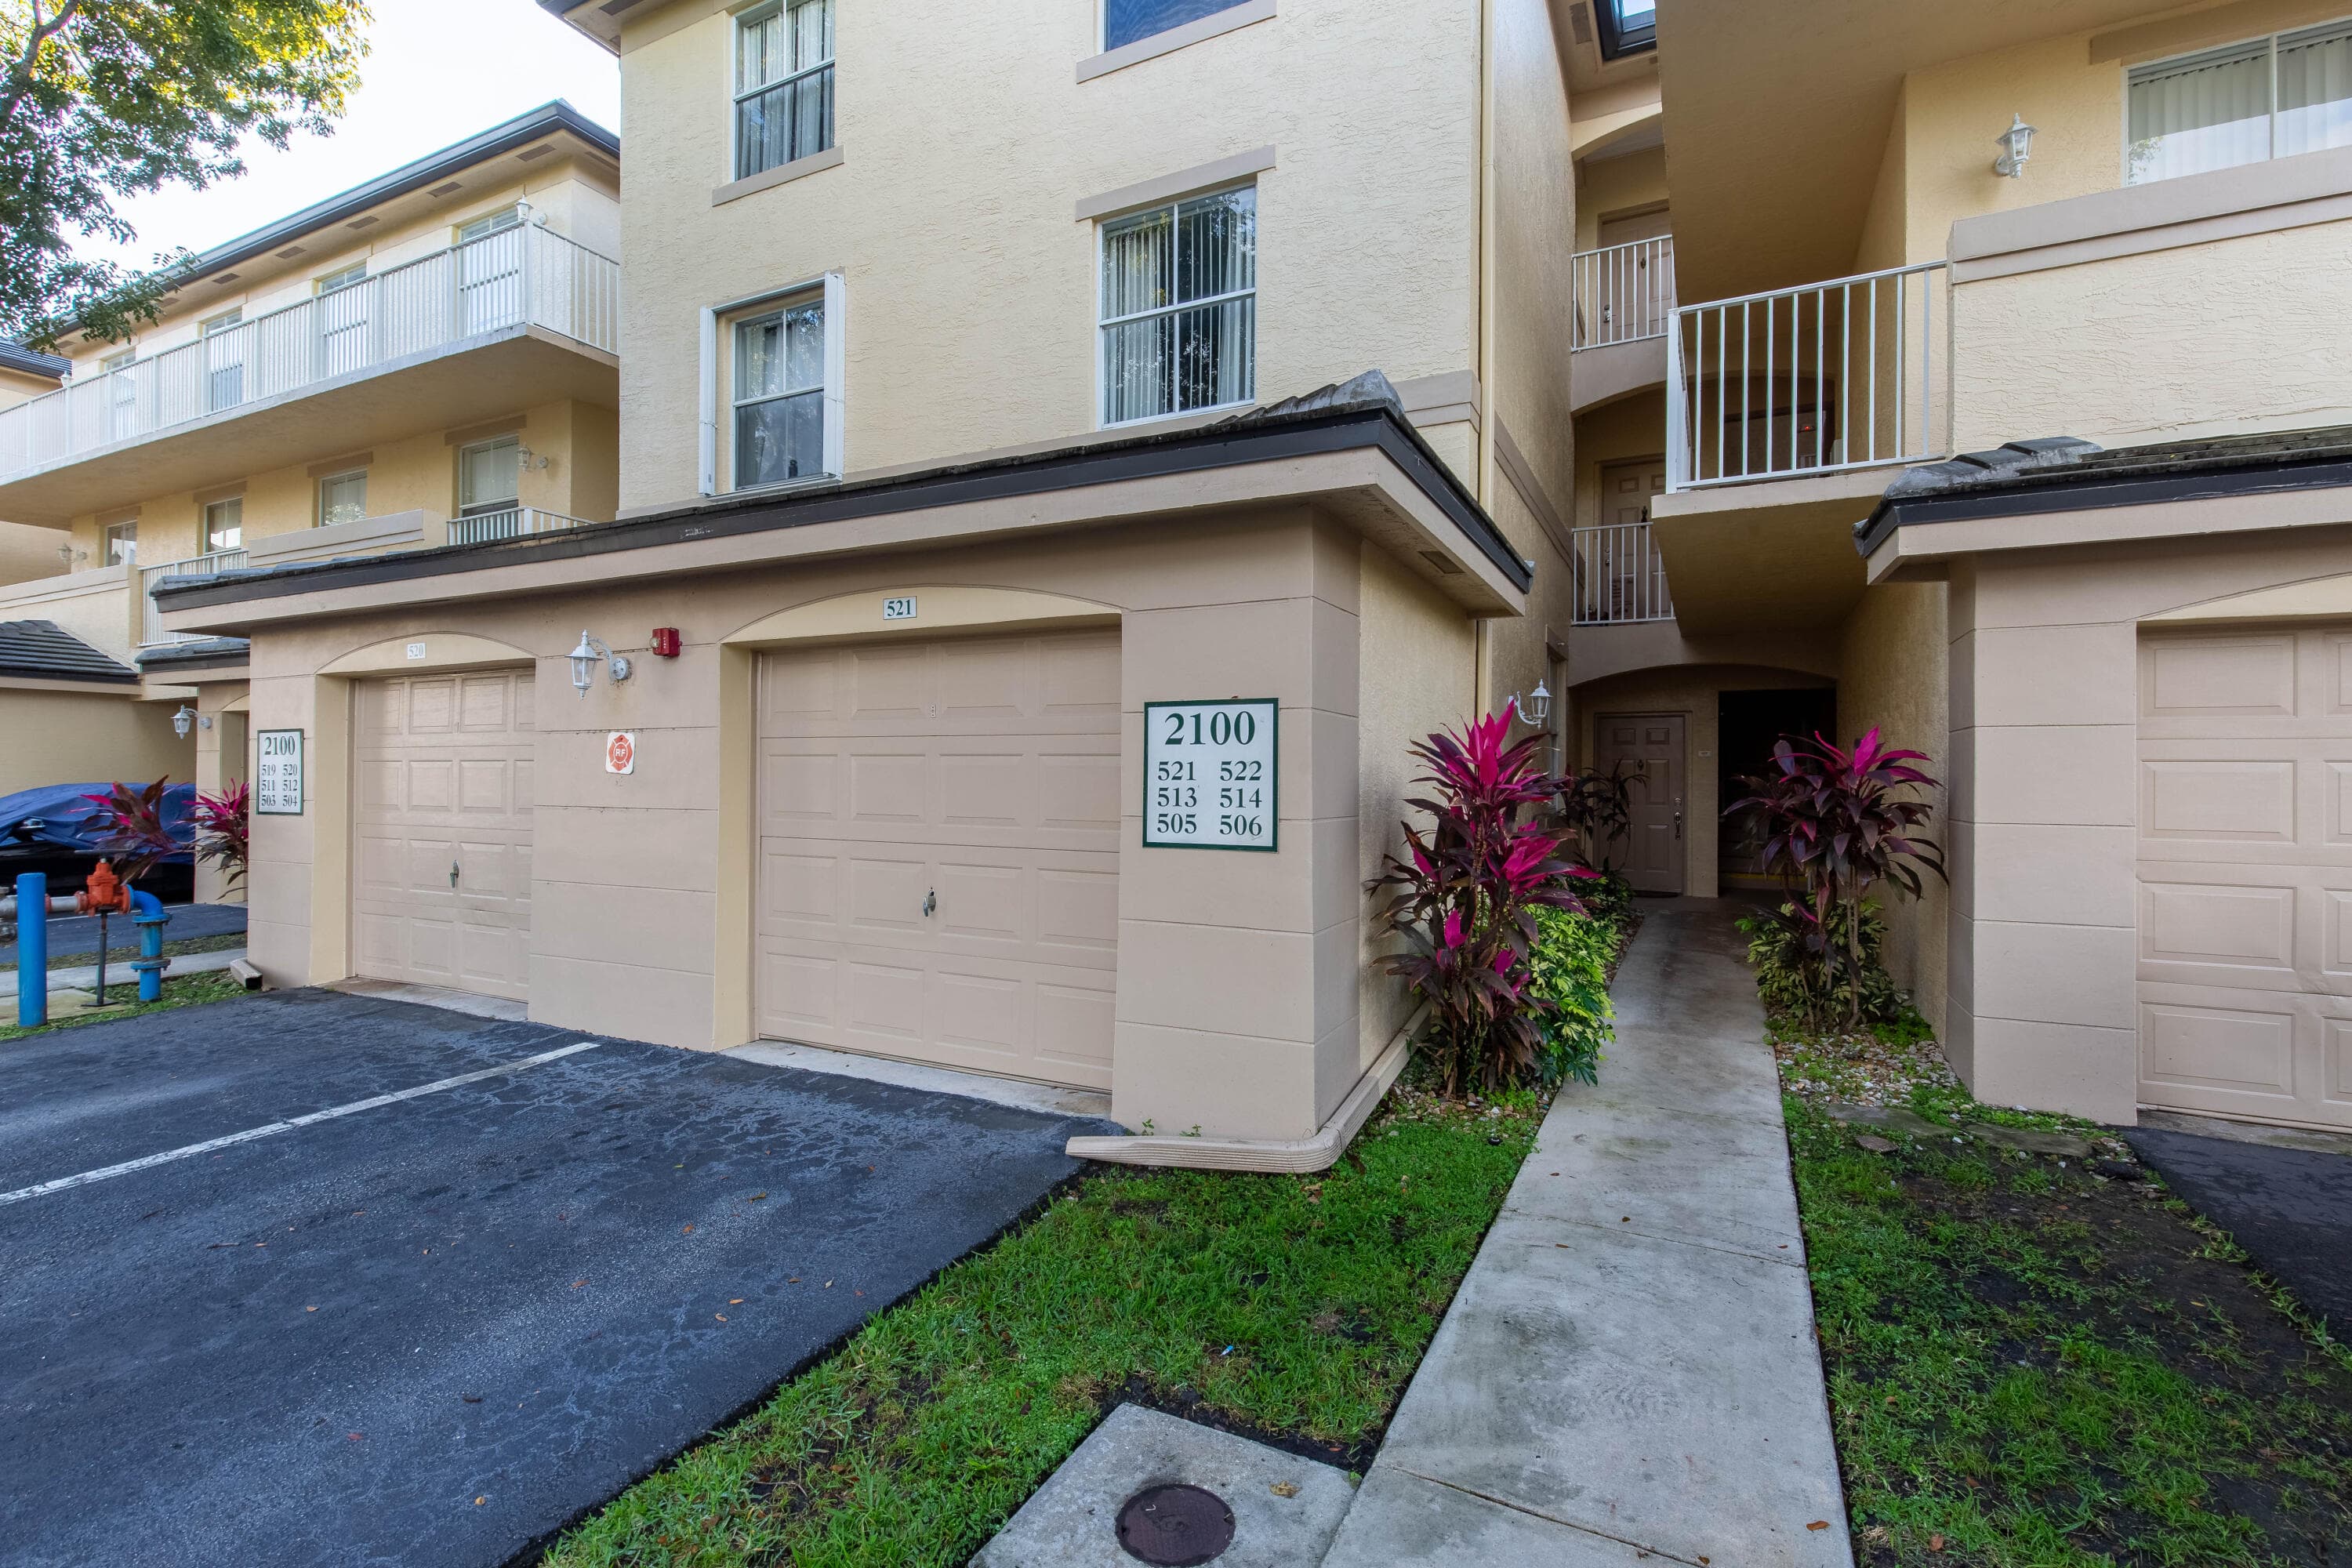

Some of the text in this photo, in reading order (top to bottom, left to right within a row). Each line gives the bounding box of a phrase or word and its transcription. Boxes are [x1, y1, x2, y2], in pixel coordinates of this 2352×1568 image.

[887, 600, 911, 616] 521
[409, 645, 423, 657] 520
[1165, 711, 1255, 745] 2100
[264, 736, 296, 755] 2100
[262, 764, 297, 775] 519 520
[1158, 760, 1261, 781] 521 522
[262, 779, 297, 791] 511 512
[261, 795, 297, 807] 503 504
[1157, 787, 1262, 808] 513 514
[1157, 813, 1262, 836] 505 506
